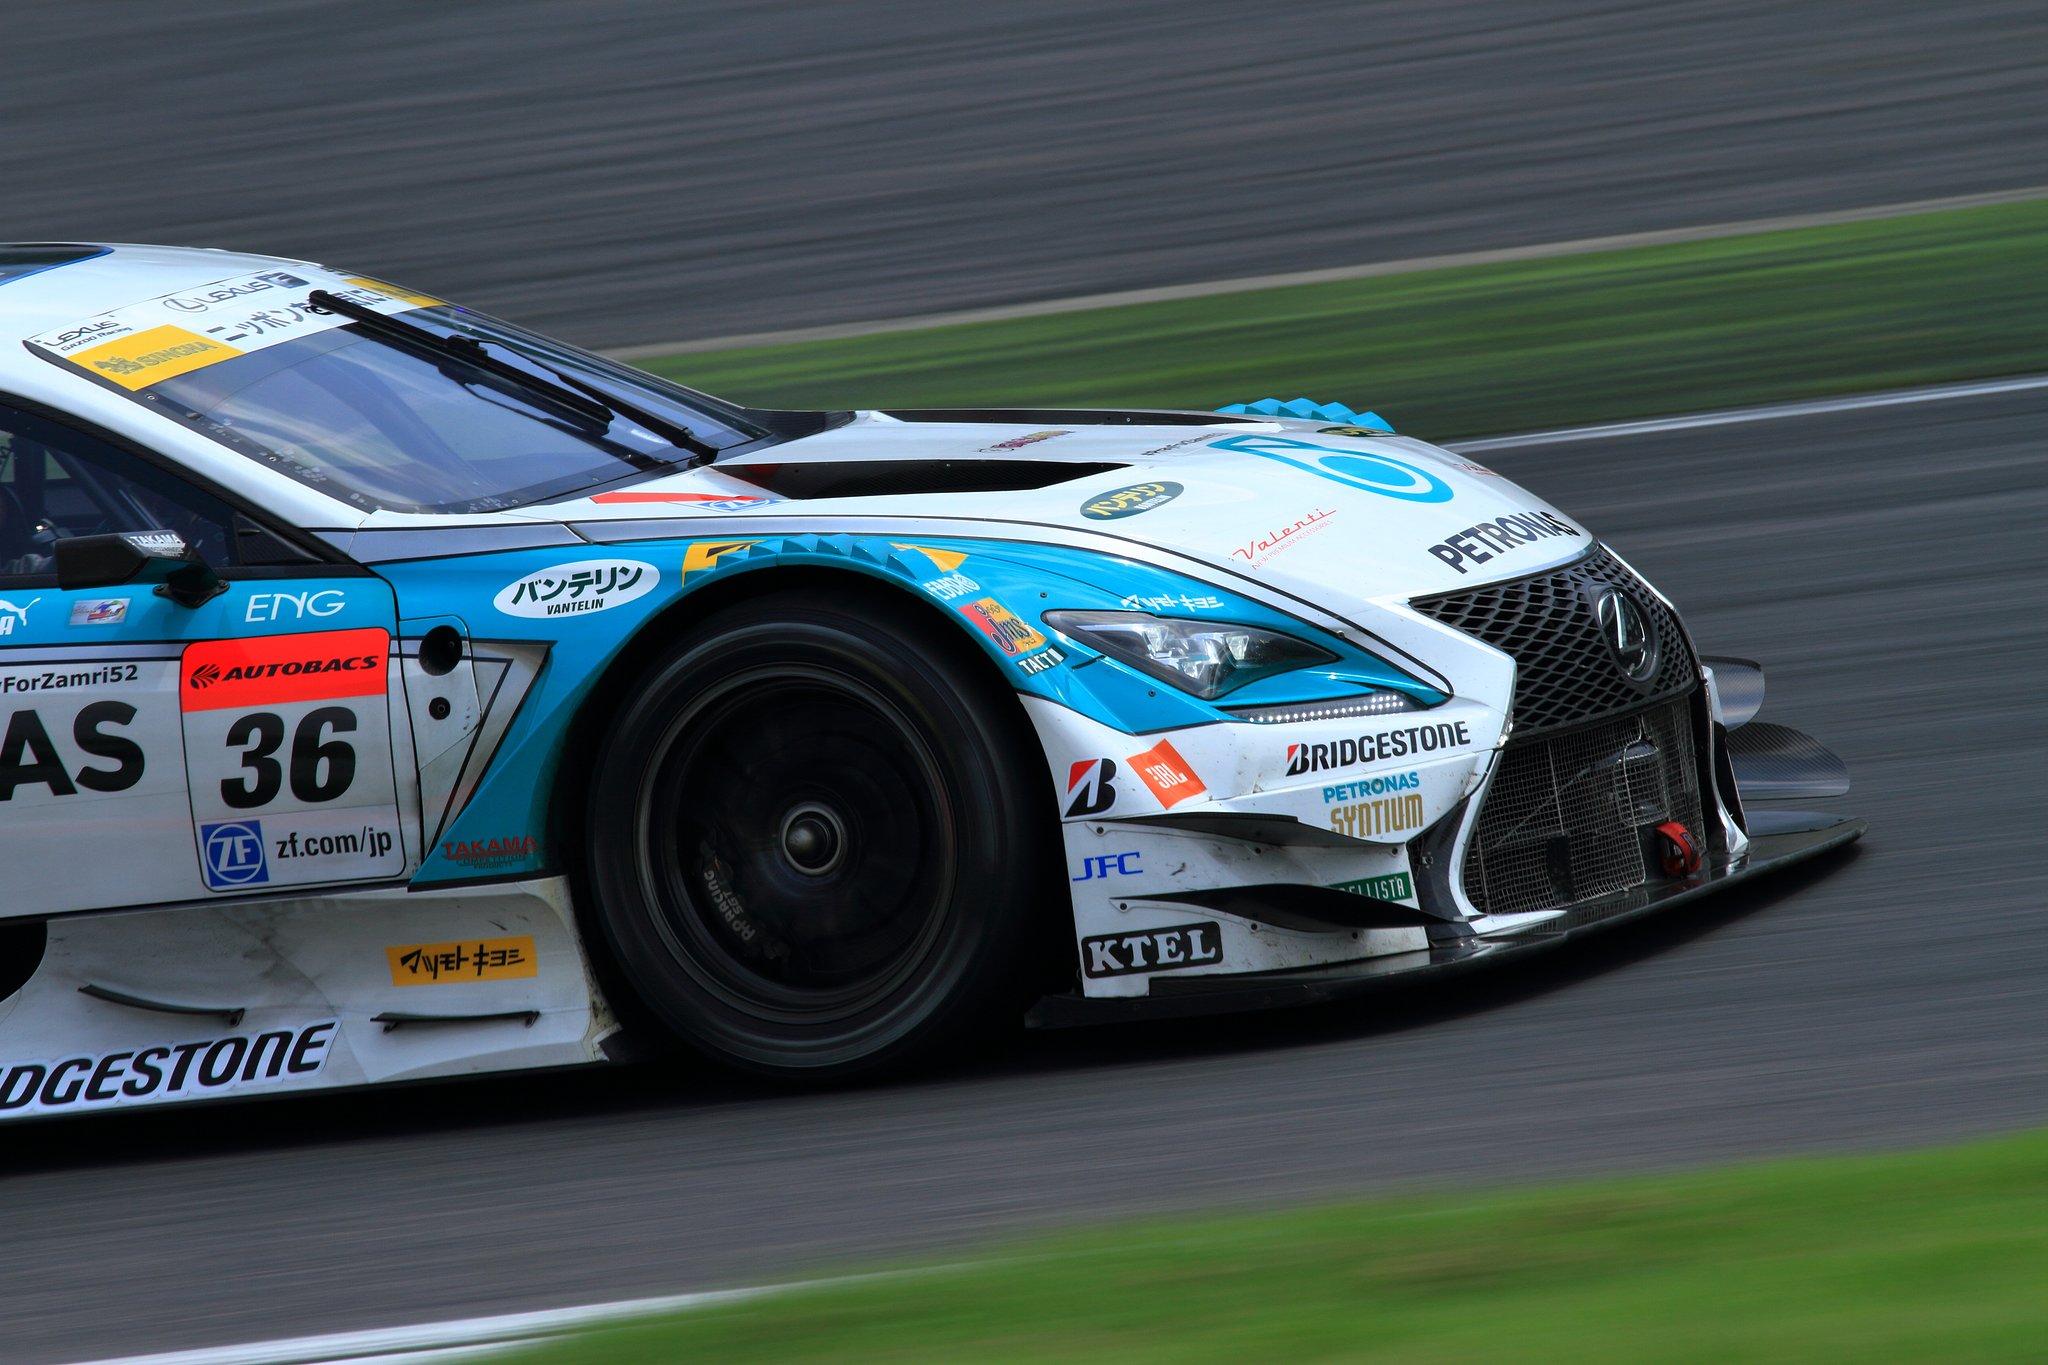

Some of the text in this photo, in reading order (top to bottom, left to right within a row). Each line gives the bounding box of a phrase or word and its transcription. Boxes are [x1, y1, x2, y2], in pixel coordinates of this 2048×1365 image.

[194, 281, 275, 304] LEXUS
[43, 321, 120, 347] LEXUS
[60, 327, 133, 351] GAZOO Racing
[136, 341, 218, 367] SINGHA
[1086, 483, 1166, 517] バンテリン
[1232, 508, 1337, 560] Valenti
[1427, 511, 1581, 575] PETRONAS
[511, 565, 643, 606] バンテリン
[245, 589, 346, 623] ENG
[547, 598, 604, 615] VANTELIN
[1121, 593, 1225, 613] マツモトキヨシ
[0, 665, 139, 695] ForZamri52
[222, 655, 380, 682] AUTOBACS
[221, 706, 358, 810] 36
[1285, 721, 1471, 777] BRIDGESTONE
[1323, 772, 1420, 804] PETRONAS
[207, 832, 259, 876] ZF
[275, 826, 392, 860] zf.com/jp
[442, 835, 539, 858] TAKAMA
[1072, 851, 1144, 882] JFC
[400, 944, 526, 980] マツモトキヨシ
[1088, 929, 1217, 973] KTEL
[0, 1022, 336, 1110] DGESTONE
